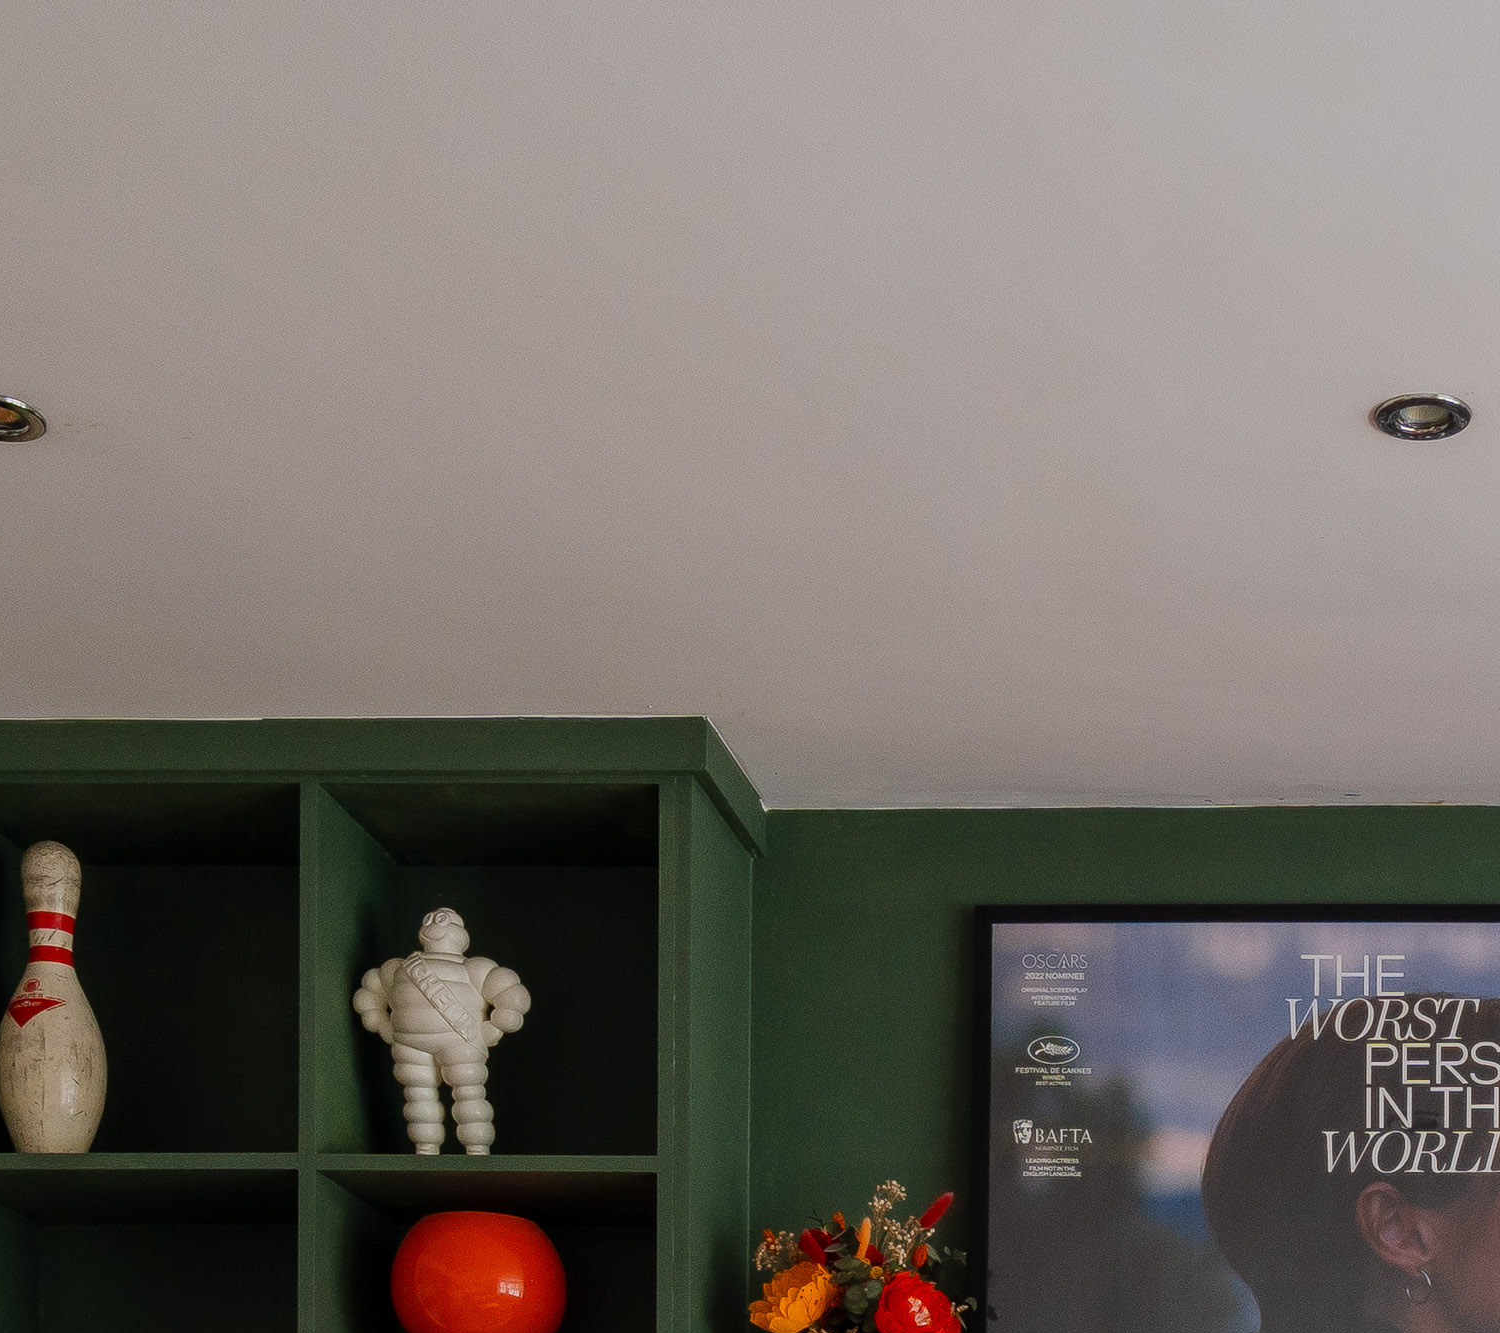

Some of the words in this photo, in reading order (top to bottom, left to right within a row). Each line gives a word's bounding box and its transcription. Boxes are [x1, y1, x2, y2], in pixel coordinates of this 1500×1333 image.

[1022, 954, 1088, 969] OSCARS
[1301, 955, 1405, 996] THE
[1285, 998, 1481, 1041] WORST
[1366, 1086, 1413, 1128] IN
[1035, 1129, 1092, 1144] BAFTA
